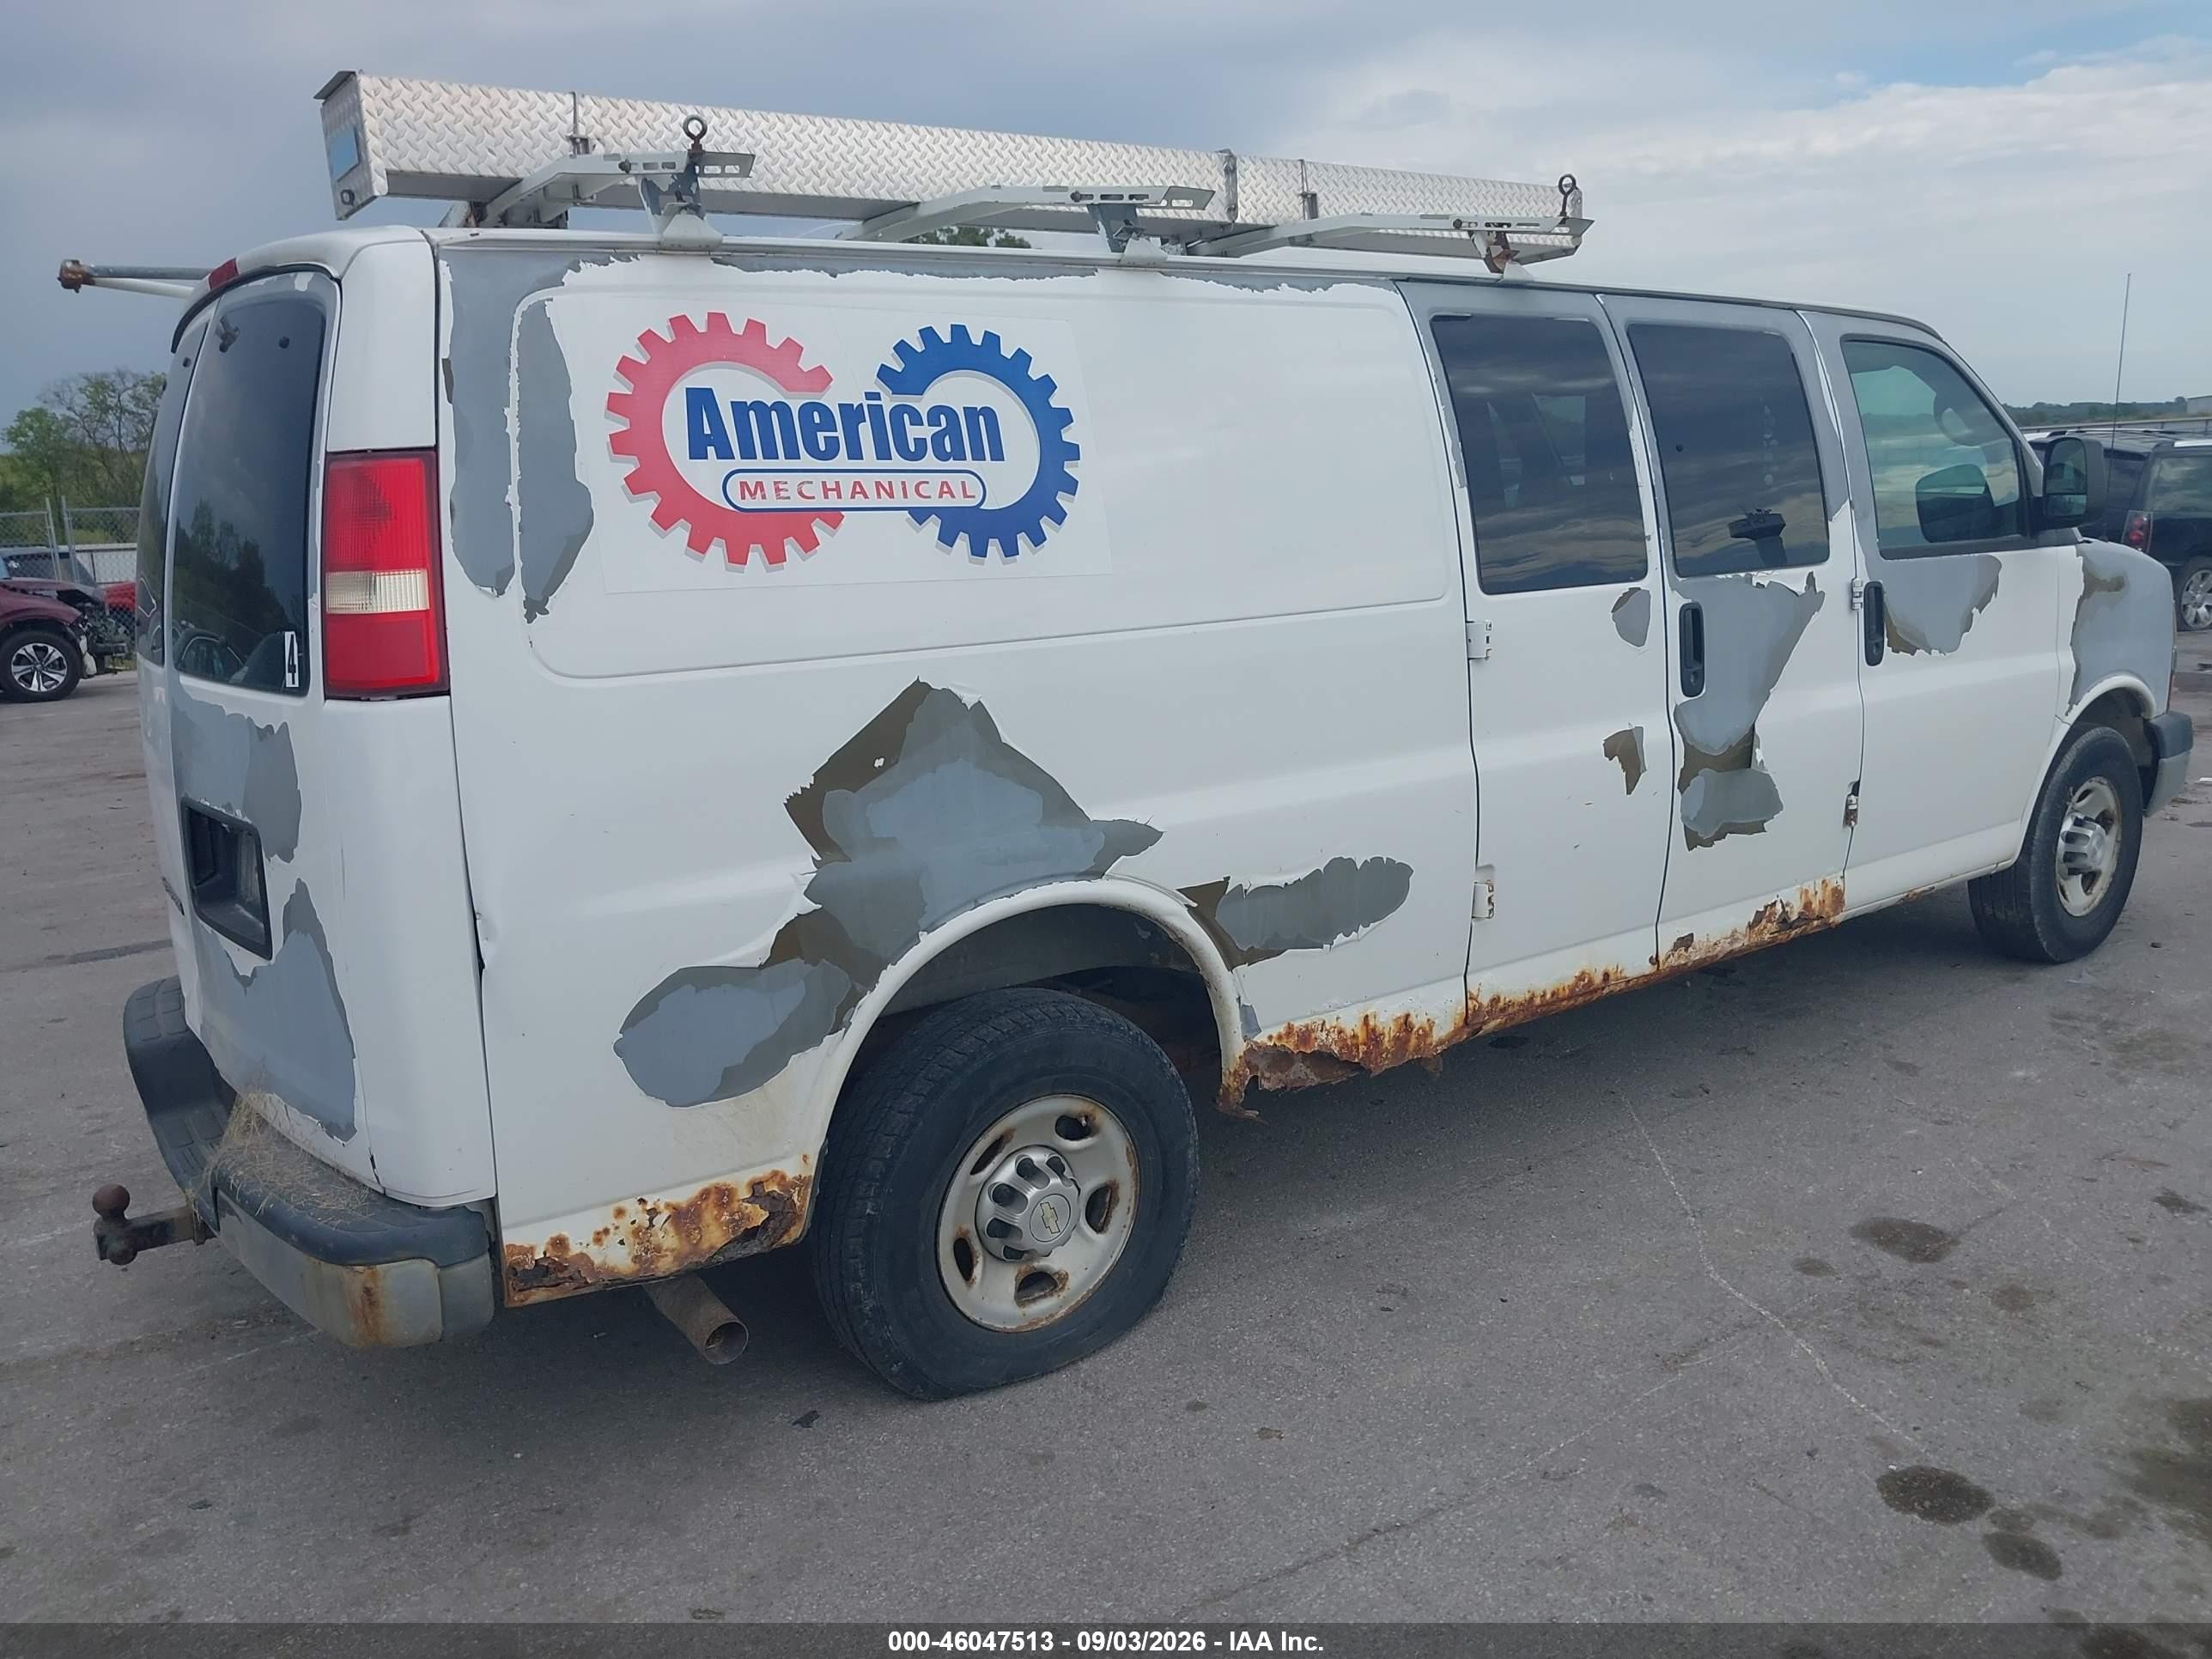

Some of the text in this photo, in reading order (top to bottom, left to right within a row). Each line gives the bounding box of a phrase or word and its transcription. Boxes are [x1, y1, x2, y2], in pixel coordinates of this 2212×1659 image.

[684, 387, 1006, 462] American
[738, 479, 976, 501] MECHANICAL
[288, 634, 296, 685] 4
